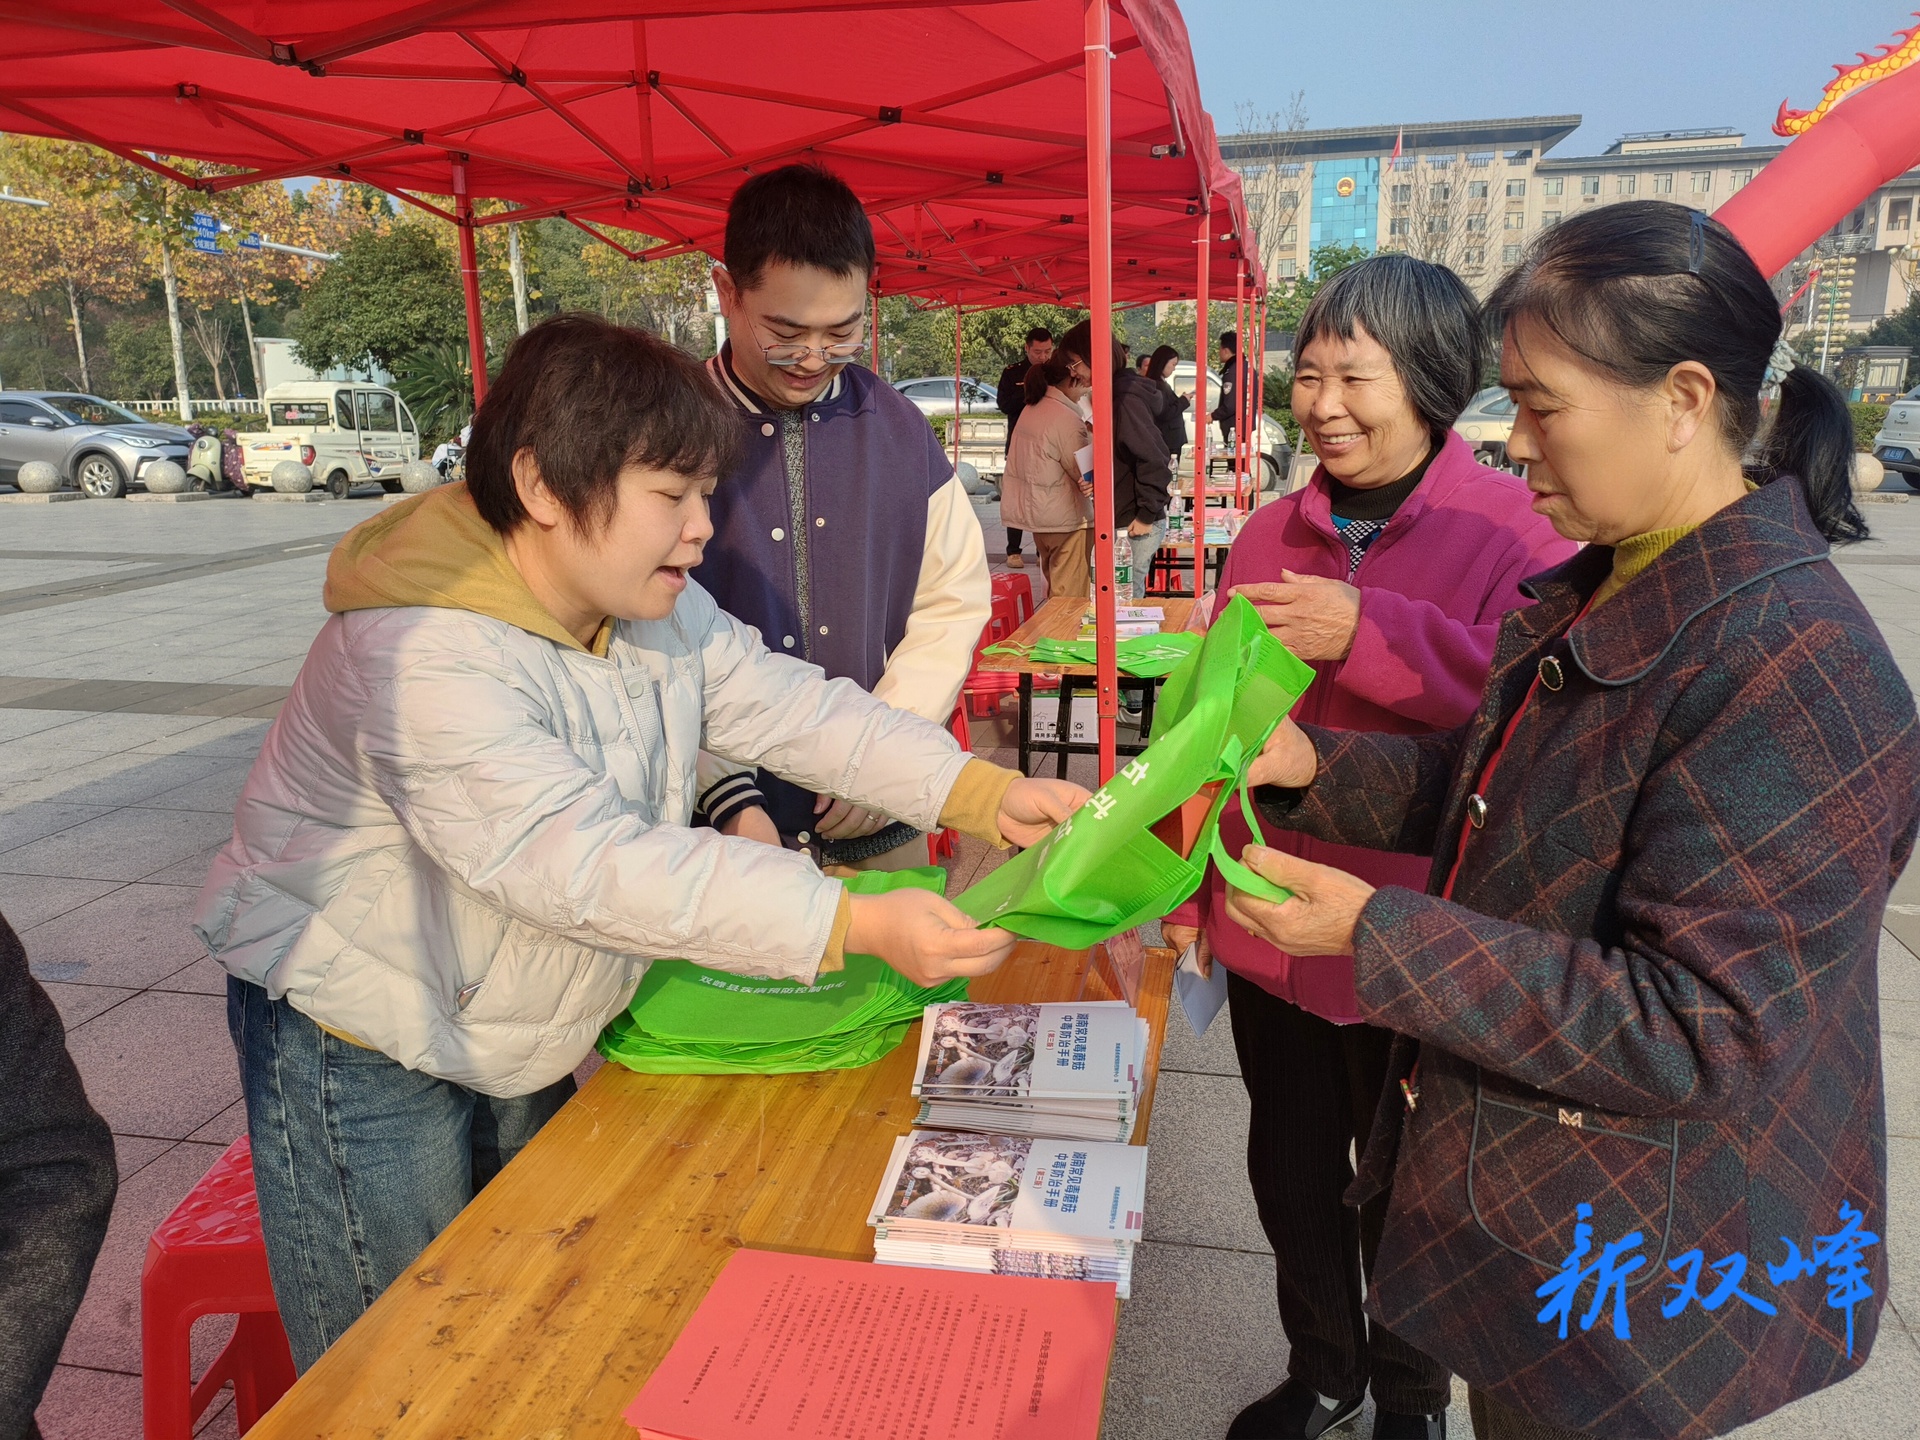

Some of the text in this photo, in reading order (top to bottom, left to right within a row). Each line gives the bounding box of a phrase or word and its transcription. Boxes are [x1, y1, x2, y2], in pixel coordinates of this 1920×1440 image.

[698, 975, 848, 994] 双峰县疾病预防控制中心
[1056, 1014, 1073, 1067] 中毒防治手册
[1071, 1012, 1089, 1070] 湖南常见毒蘑菇
[1043, 1152, 1069, 1208] 中毒防治手册
[1060, 1151, 1088, 1214] 湖南常见毒蘑菇
